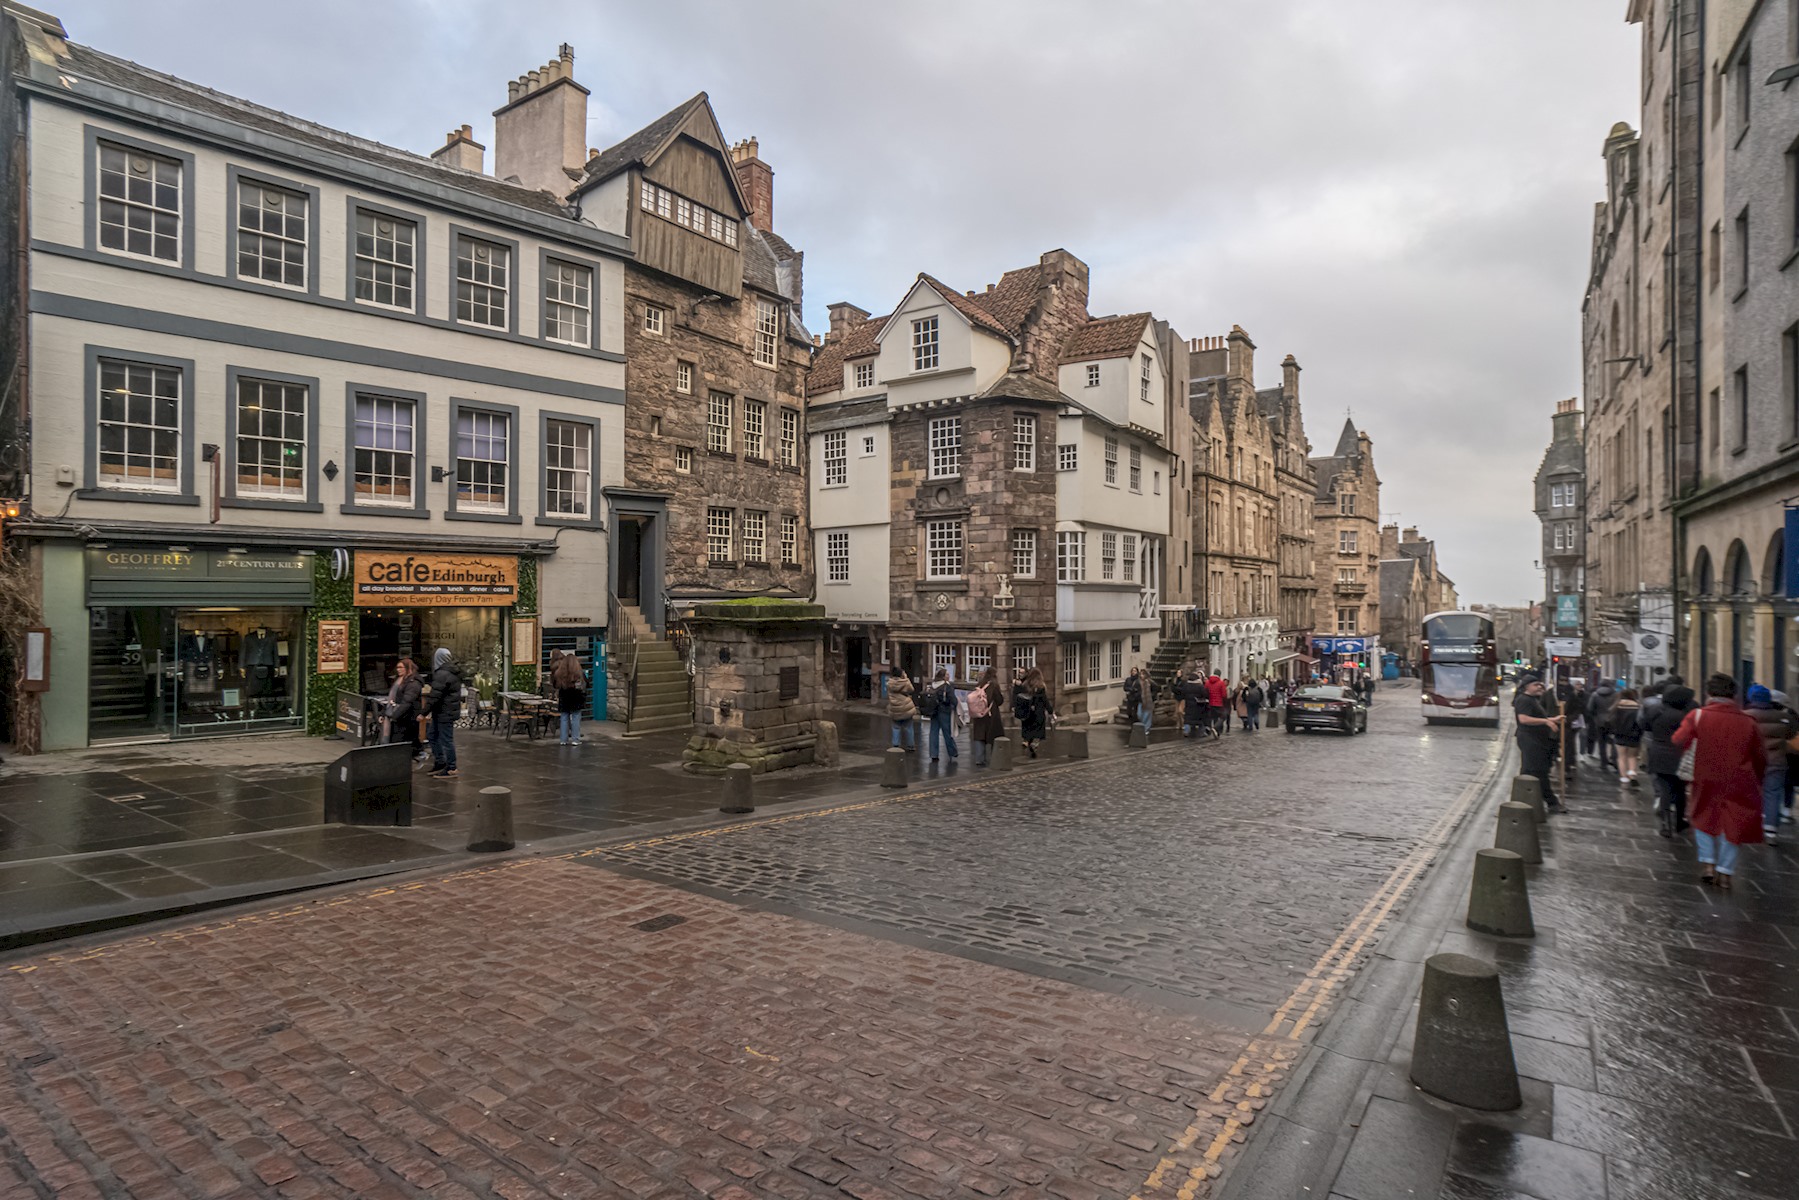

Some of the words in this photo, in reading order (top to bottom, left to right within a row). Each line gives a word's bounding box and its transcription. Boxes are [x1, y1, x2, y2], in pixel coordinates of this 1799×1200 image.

[106, 552, 194, 566] GEOFFREY
[233, 559, 277, 569] CENTURY
[277, 560, 304, 569] KILTS
[368, 556, 430, 582] cafe
[432, 569, 506, 585] Edinburgh
[383, 595, 408, 604] Open
[409, 595, 433, 604] Every
[435, 595, 453, 605] Day
[454, 595, 475, 603] From
[476, 595, 494, 603] 7am
[121, 652, 142, 666] 59
